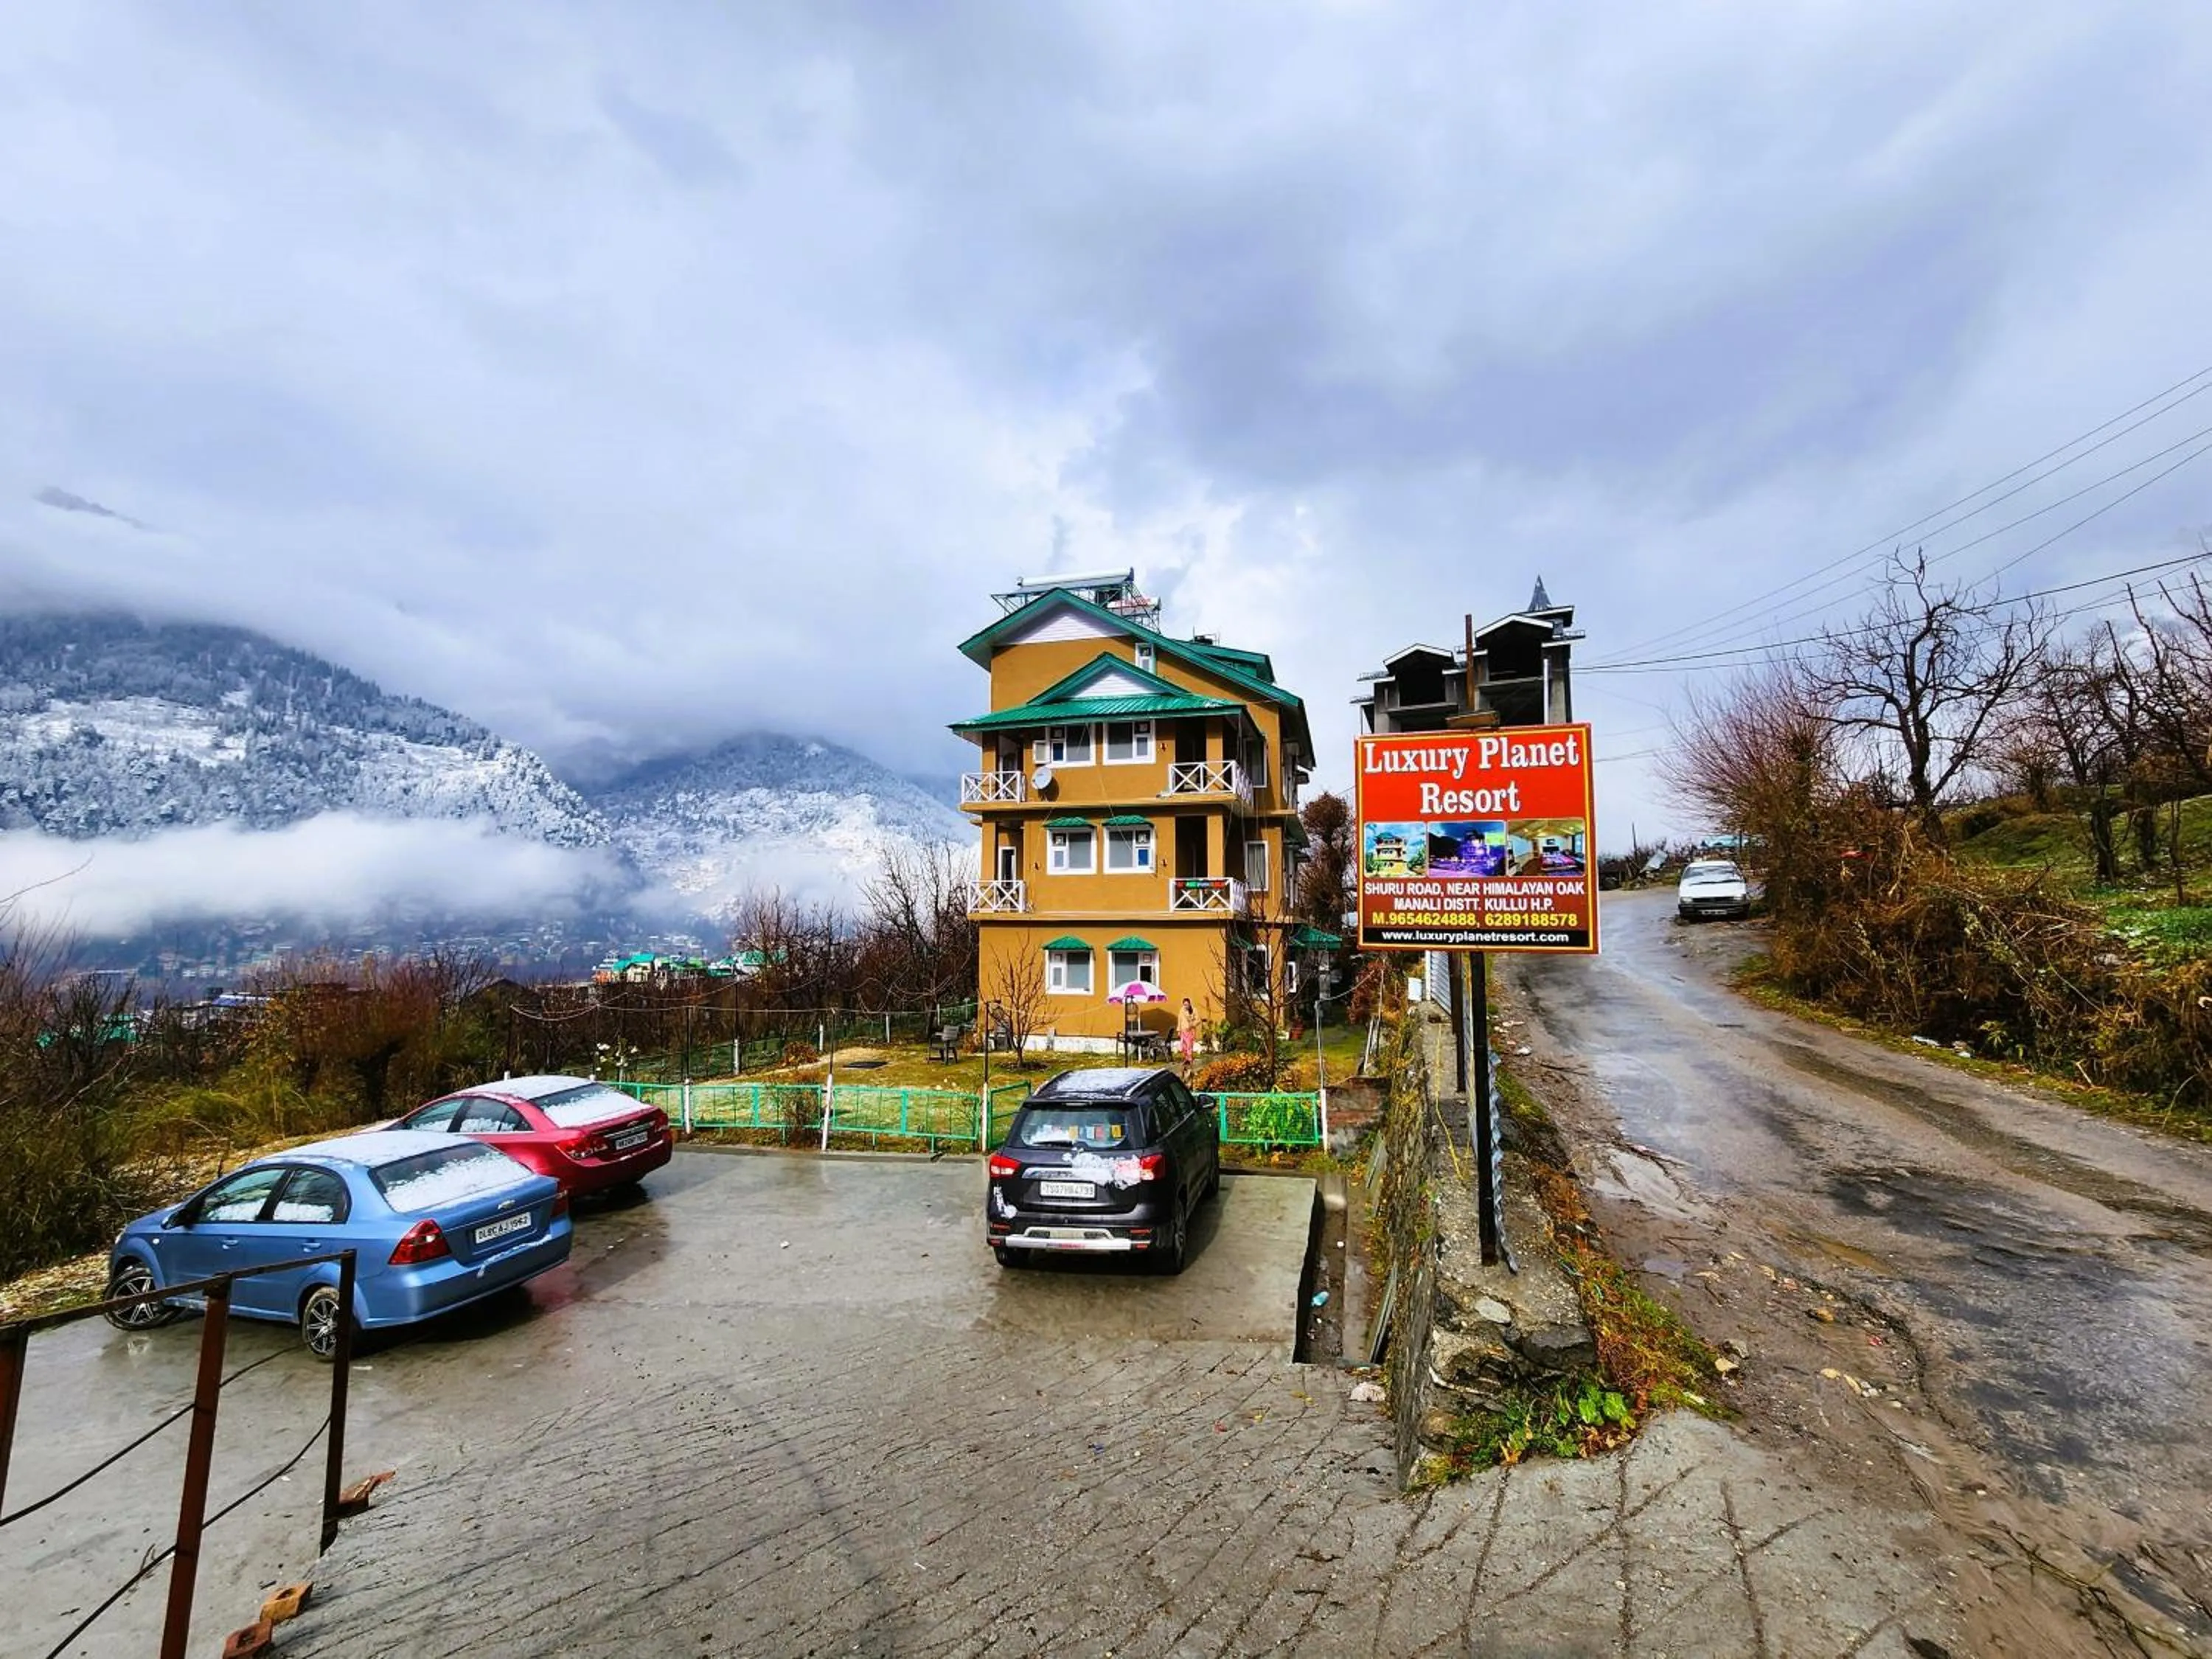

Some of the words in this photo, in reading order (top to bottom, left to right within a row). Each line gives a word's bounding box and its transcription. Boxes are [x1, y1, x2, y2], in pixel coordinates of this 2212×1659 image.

[1364, 743, 1470, 779] Luxury
[1478, 734, 1579, 768] Planet
[1420, 781, 1520, 814] Resort
[1365, 882, 1404, 895] SHURU
[1407, 882, 1444, 896] ROAD,
[1447, 882, 1481, 894] NEAR
[1483, 882, 1553, 894] HIMALAYAN
[1557, 881, 1584, 894] OAK
[1394, 898, 1441, 911] MANALI
[1444, 898, 1481, 911] DISTT.
[1484, 898, 1527, 911] KULLU
[1531, 898, 1554, 911] H.P.
[1484, 914, 1578, 927] 6289188578
[1382, 929, 1569, 943] www.luxuryplanetresort.com
